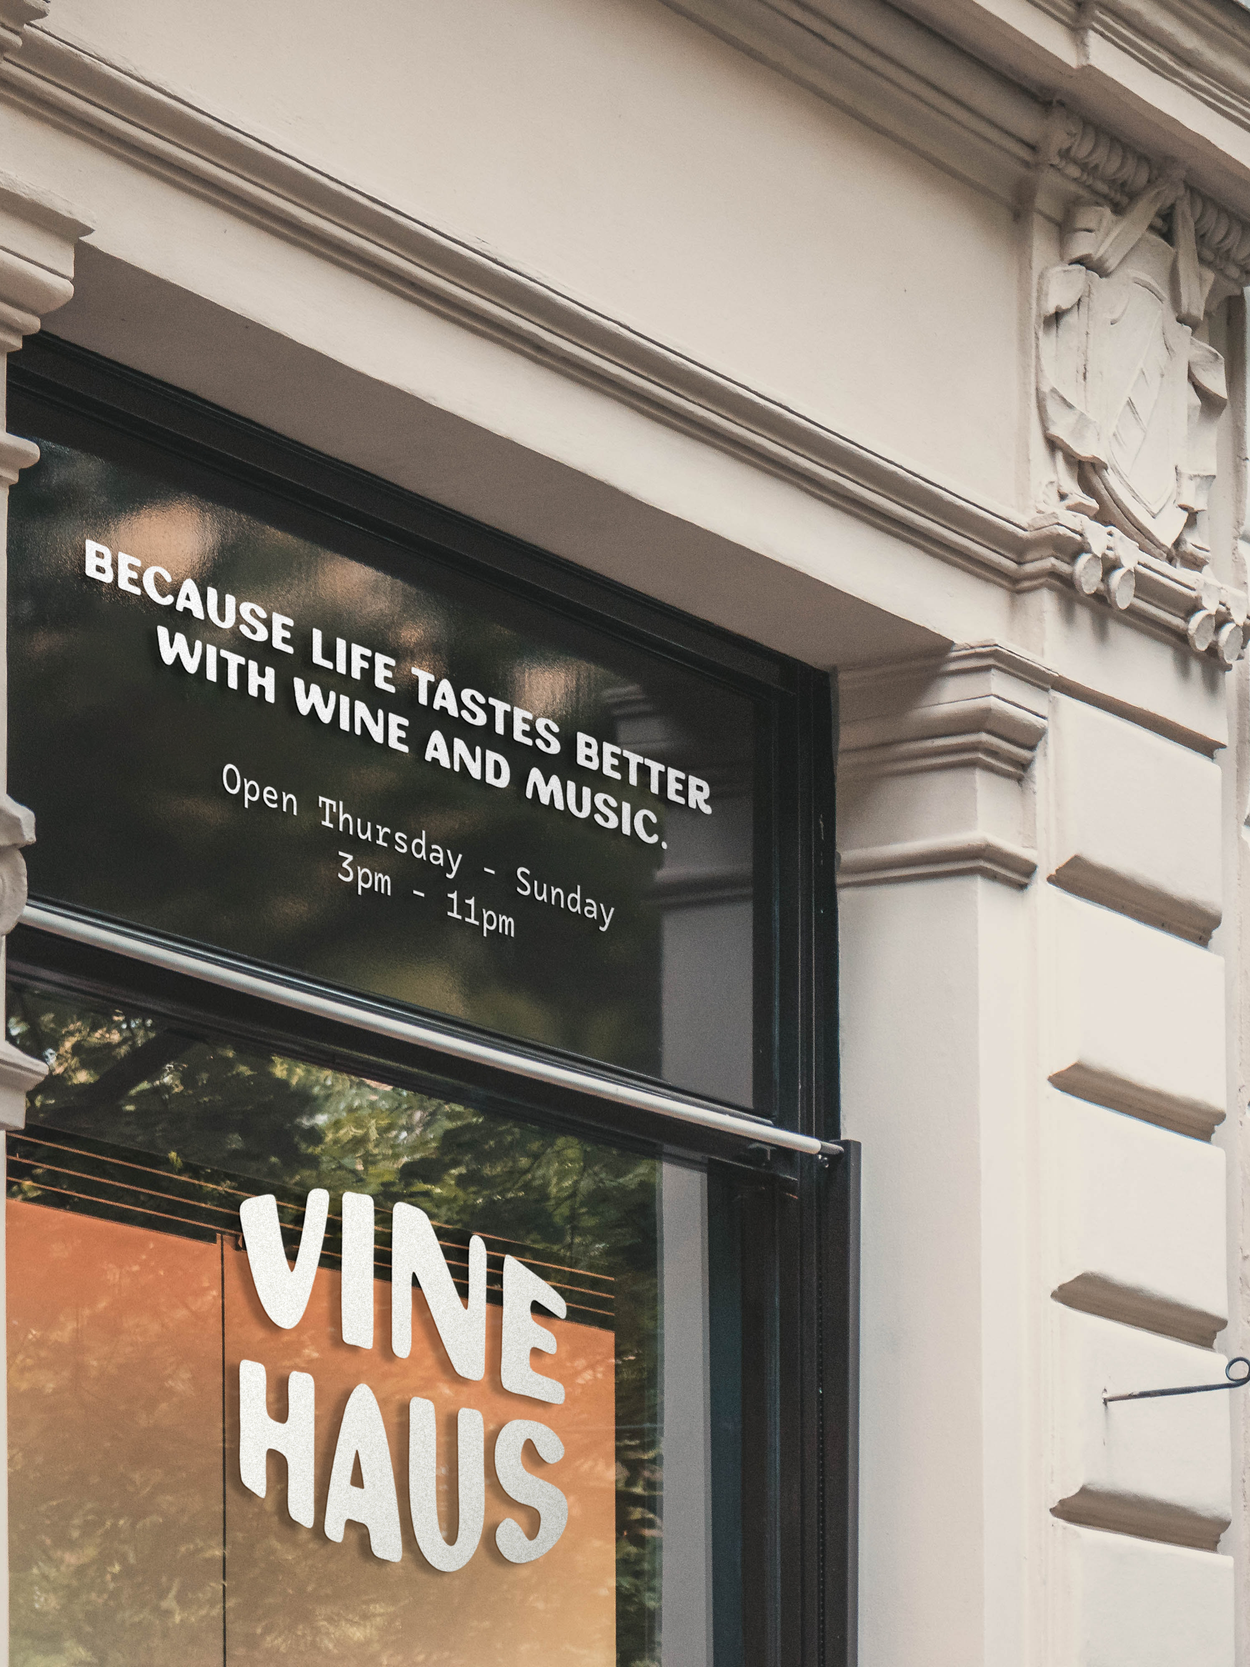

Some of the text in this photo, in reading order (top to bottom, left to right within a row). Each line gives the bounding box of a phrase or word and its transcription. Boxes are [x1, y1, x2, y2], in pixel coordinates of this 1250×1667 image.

[84, 538, 713, 815] BECAUSE LIFE TASTES BETTER
[156, 625, 668, 850] WITH WINE AND MUSIC.
[222, 763, 297, 816] Open
[318, 795, 463, 879] Thursday
[516, 866, 615, 932] Sunday
[337, 850, 391, 896] 3pm
[447, 890, 515, 937] 11pm
[238, 1187, 568, 1405] VINE
[238, 1358, 569, 1573] HAUS
